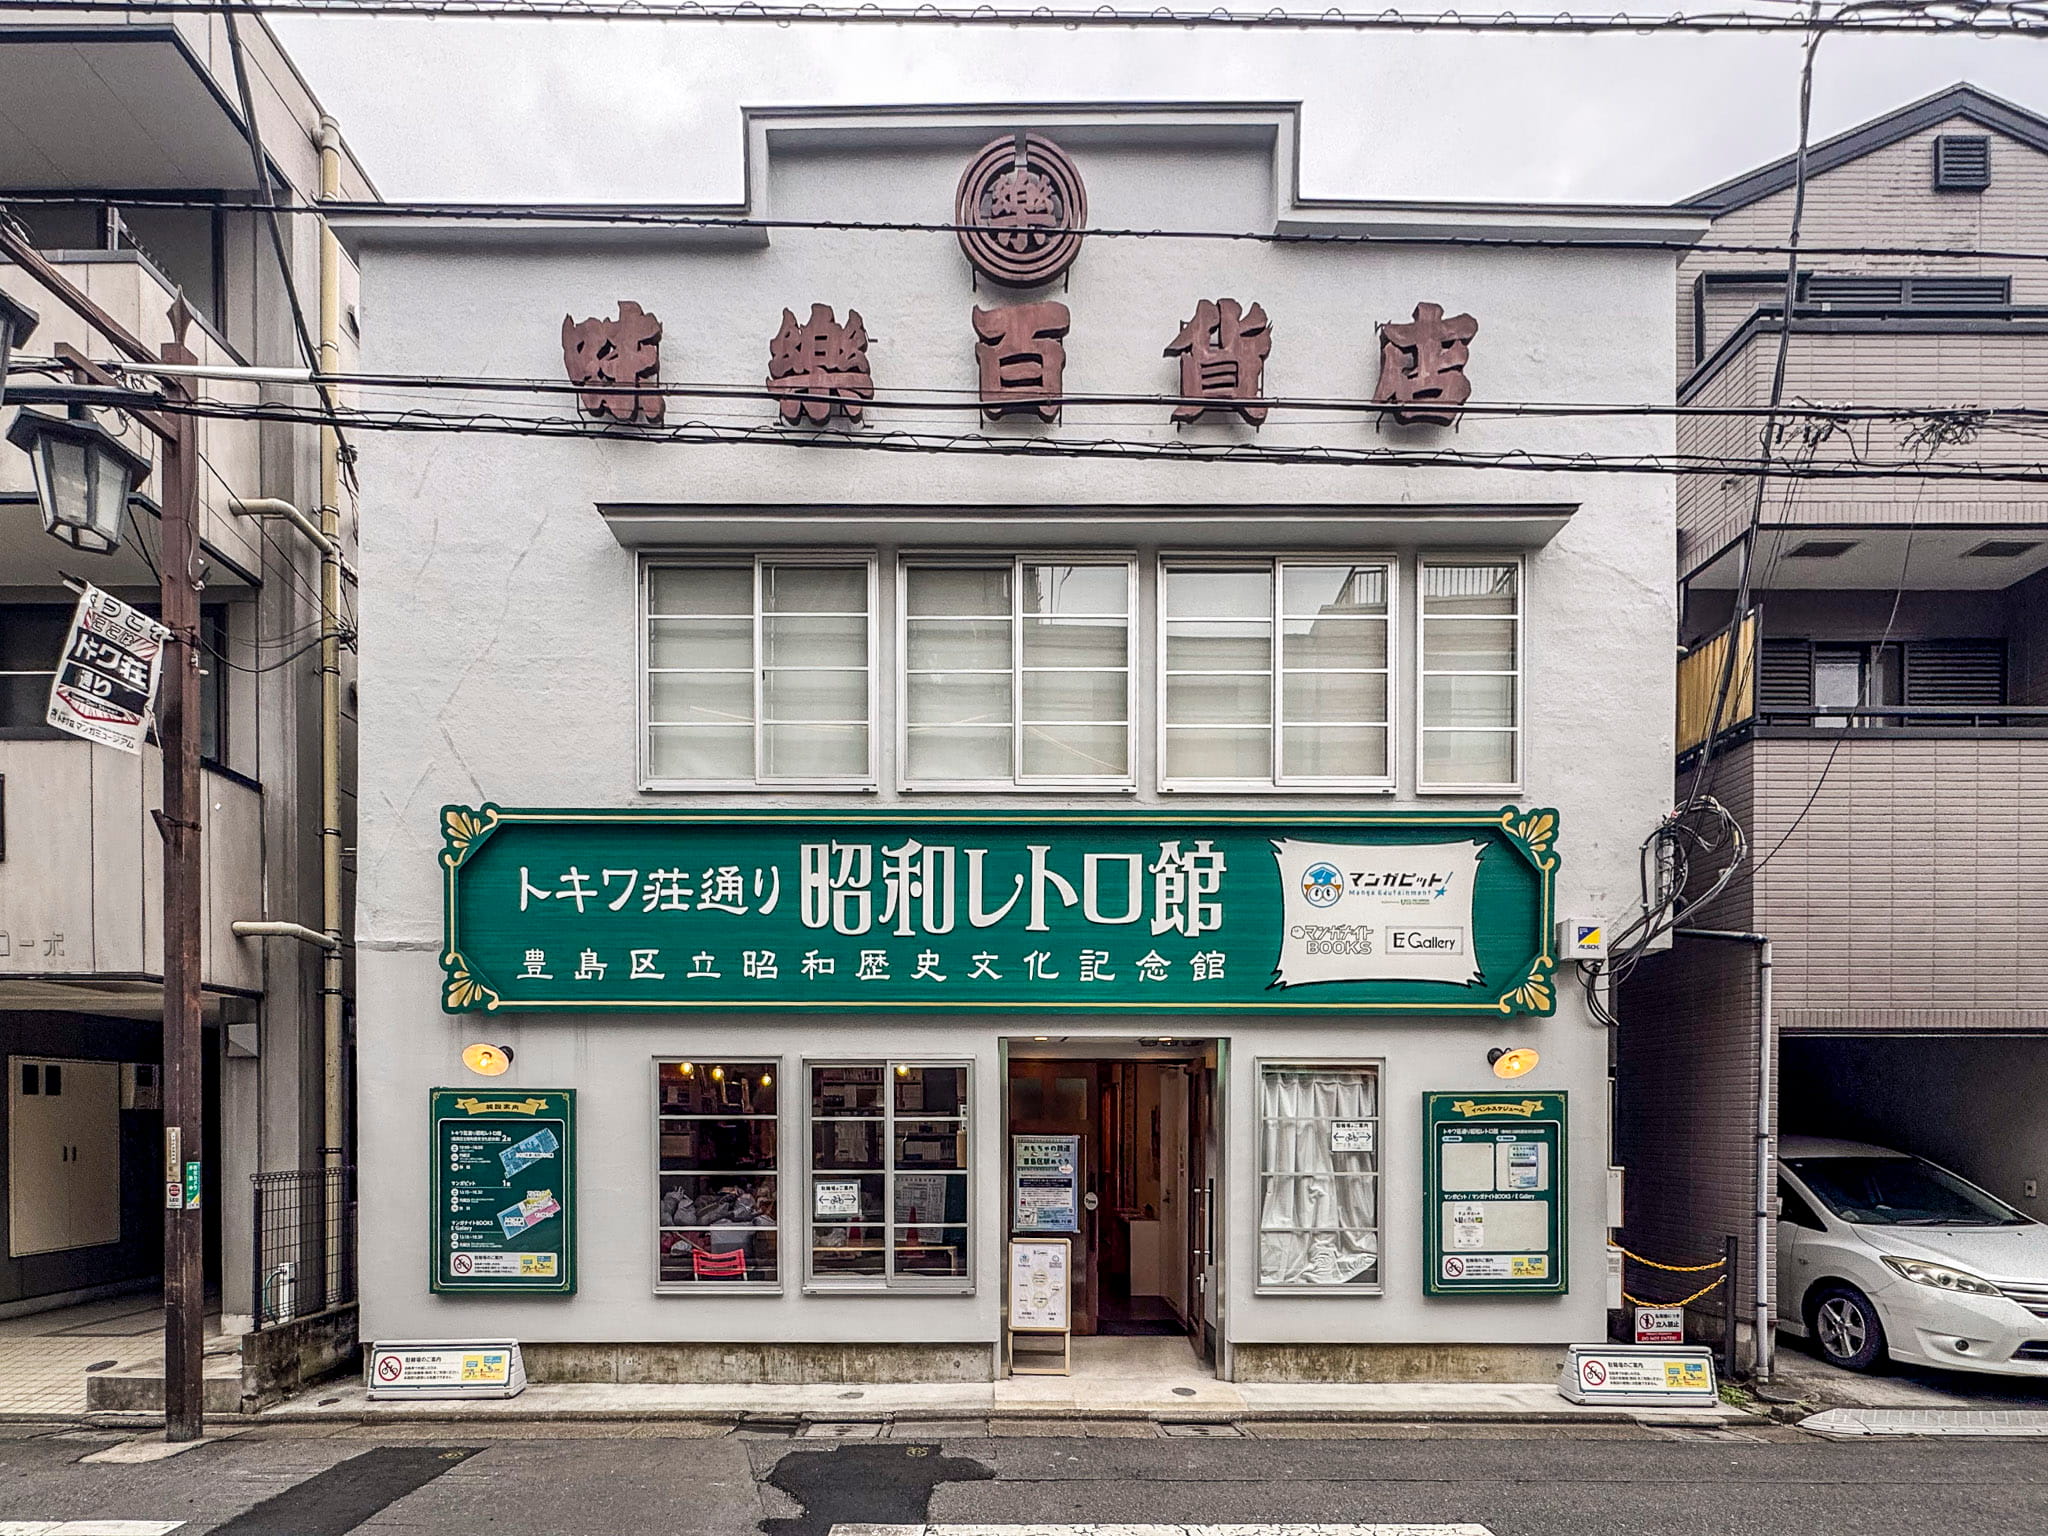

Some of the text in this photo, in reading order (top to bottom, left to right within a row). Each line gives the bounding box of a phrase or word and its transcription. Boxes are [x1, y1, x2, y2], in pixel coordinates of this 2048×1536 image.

[91, 614, 136, 648] ここは
[78, 670, 112, 697] 通り
[518, 838, 1227, 937] トキワ荘通り 昭和レトロ館
[1306, 941, 1373, 955] BOOKS
[1408, 932, 1456, 950] Gallery
[516, 948, 1226, 982] 豊島区立昭和歴史文化記念館
